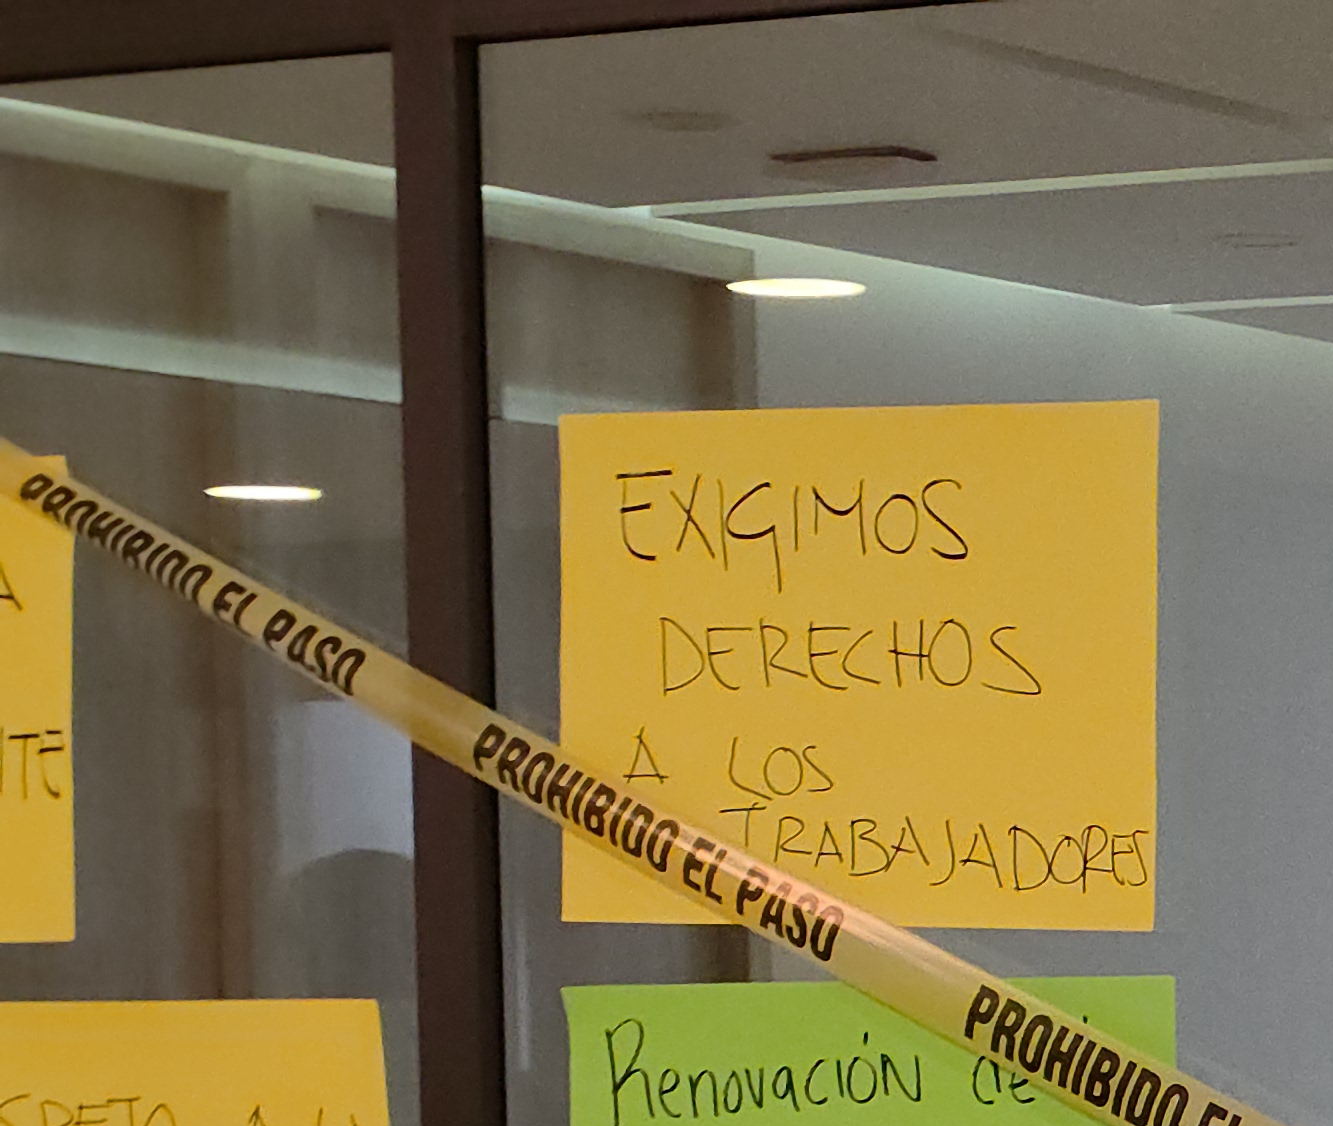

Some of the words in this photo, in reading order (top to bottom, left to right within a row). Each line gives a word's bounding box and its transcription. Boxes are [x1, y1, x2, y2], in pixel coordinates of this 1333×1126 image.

[616, 470, 968, 593] EXIGIMOS
[659, 617, 1042, 696] DERECHOS
[623, 727, 668, 784] A
[728, 736, 835, 800] LOS
[473, 724, 679, 872] PROHIBIDO
[683, 837, 727, 904] EL
[736, 866, 844, 962] PASO
[719, 802, 1149, 893] TRABAJADORES
